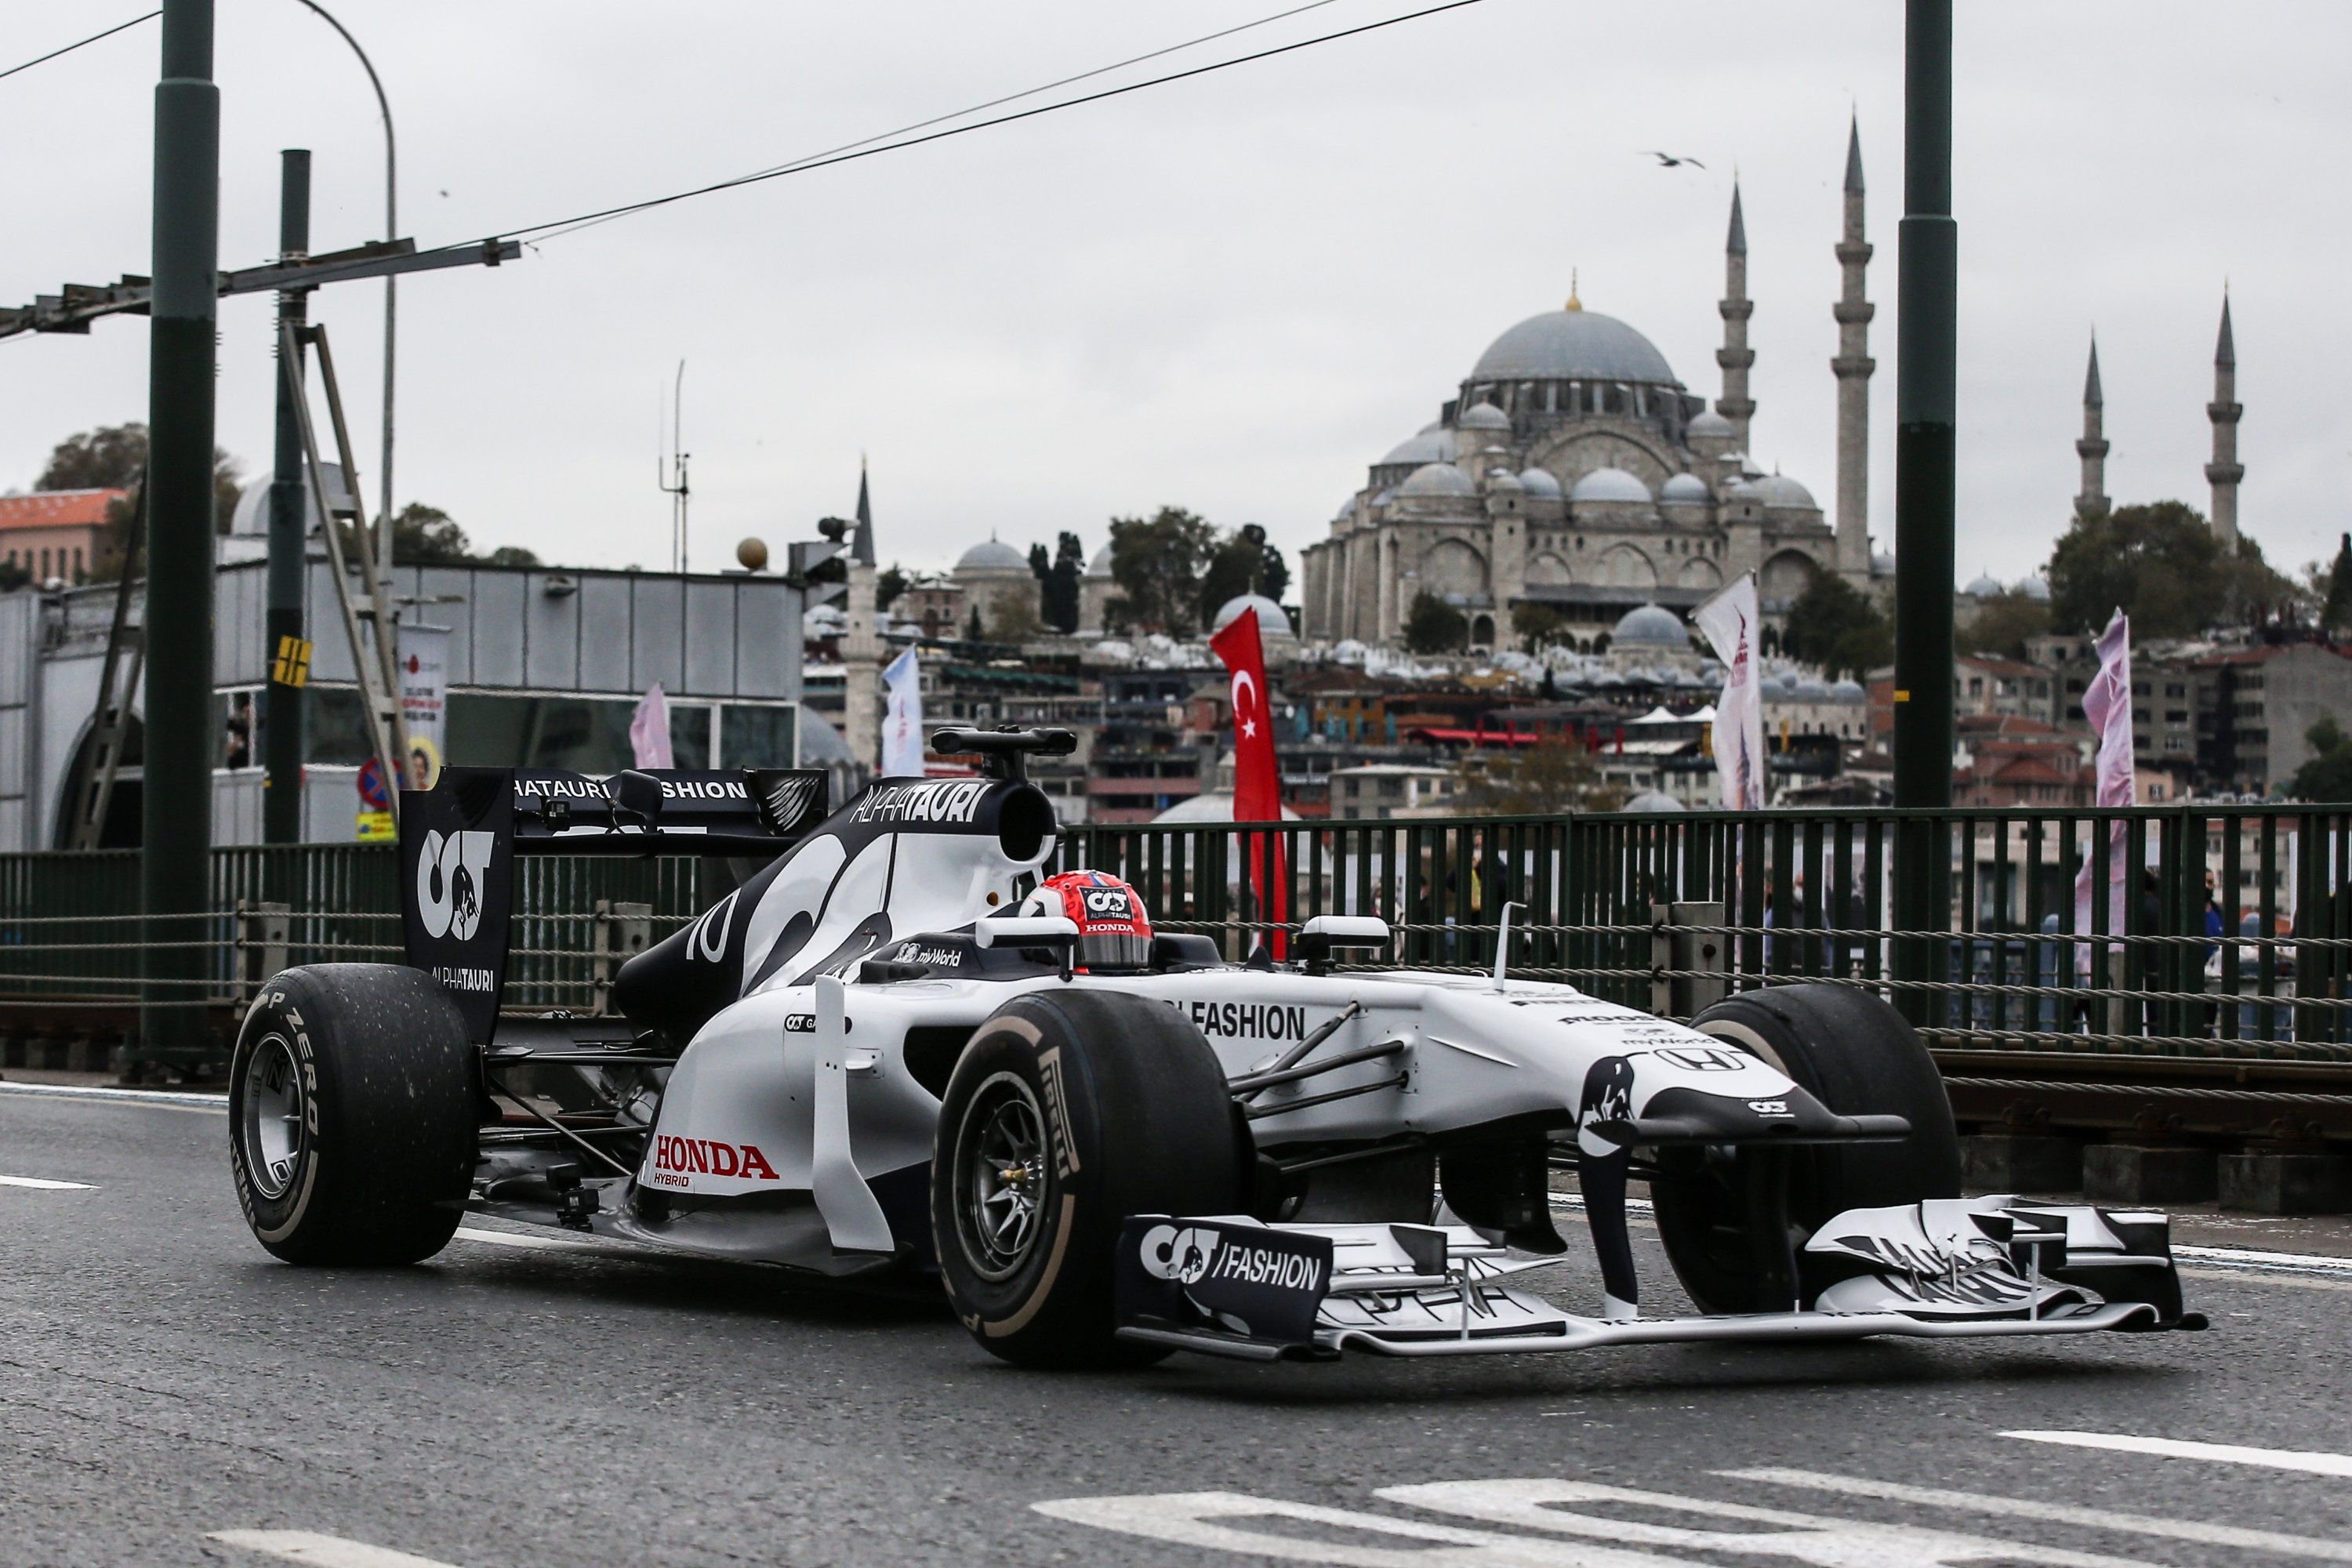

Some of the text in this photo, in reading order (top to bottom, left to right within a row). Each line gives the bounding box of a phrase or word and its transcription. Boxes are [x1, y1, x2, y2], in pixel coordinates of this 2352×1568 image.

[849, 783, 994, 823] ALPHATAURI
[1086, 923, 1135, 932] HONDA
[1091, 911, 1131, 920] ALPHATAURI
[916, 948, 962, 967] myWorld
[1192, 1001, 1305, 1041] FASHION
[1621, 1038, 1718, 1047] myWorld
[285, 1007, 318, 1136] ZERO
[1037, 1046, 1080, 1180] PIRELLI
[655, 1134, 780, 1180] HONDA
[654, 1173, 689, 1188] HYBRID
